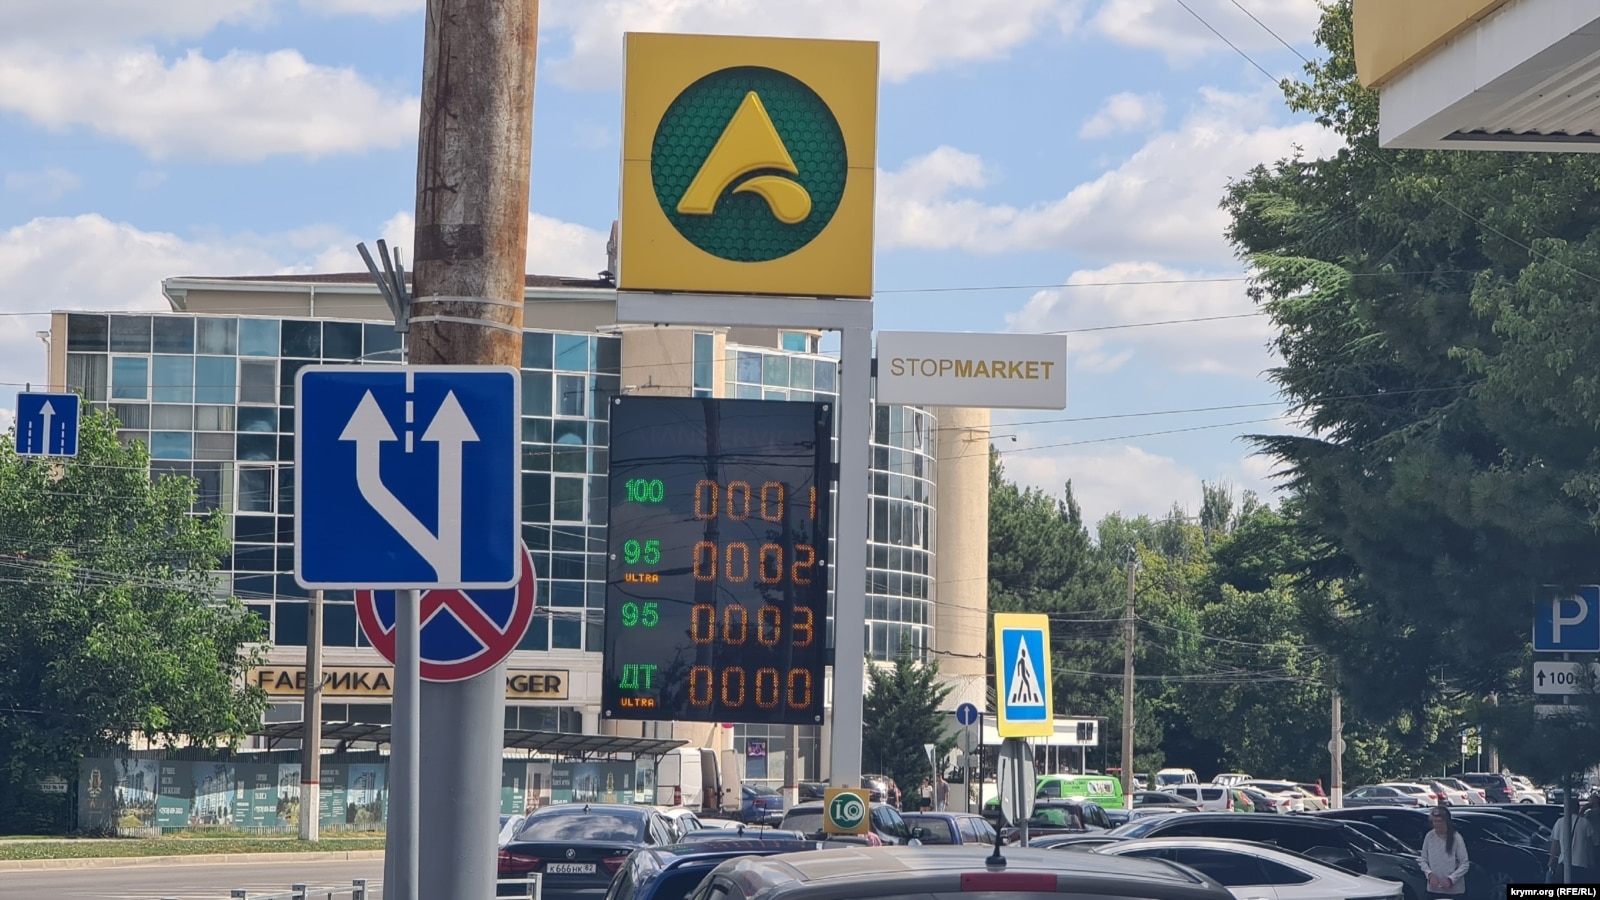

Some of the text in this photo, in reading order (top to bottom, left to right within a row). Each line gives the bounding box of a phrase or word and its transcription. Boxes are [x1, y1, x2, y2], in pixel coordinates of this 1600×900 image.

[890, 357, 1055, 380] STOPMARKET
[625, 479, 816, 522] 100 0001
[624, 539, 815, 584] 95 0002
[625, 572, 659, 583] ULTRA
[622, 602, 814, 647] 95 0003
[1552, 593, 1588, 643] P
[506, 674, 561, 693] GER
[619, 664, 658, 689] ДТ
[689, 665, 812, 709] 0000
[621, 697, 655, 708] ULTRA
